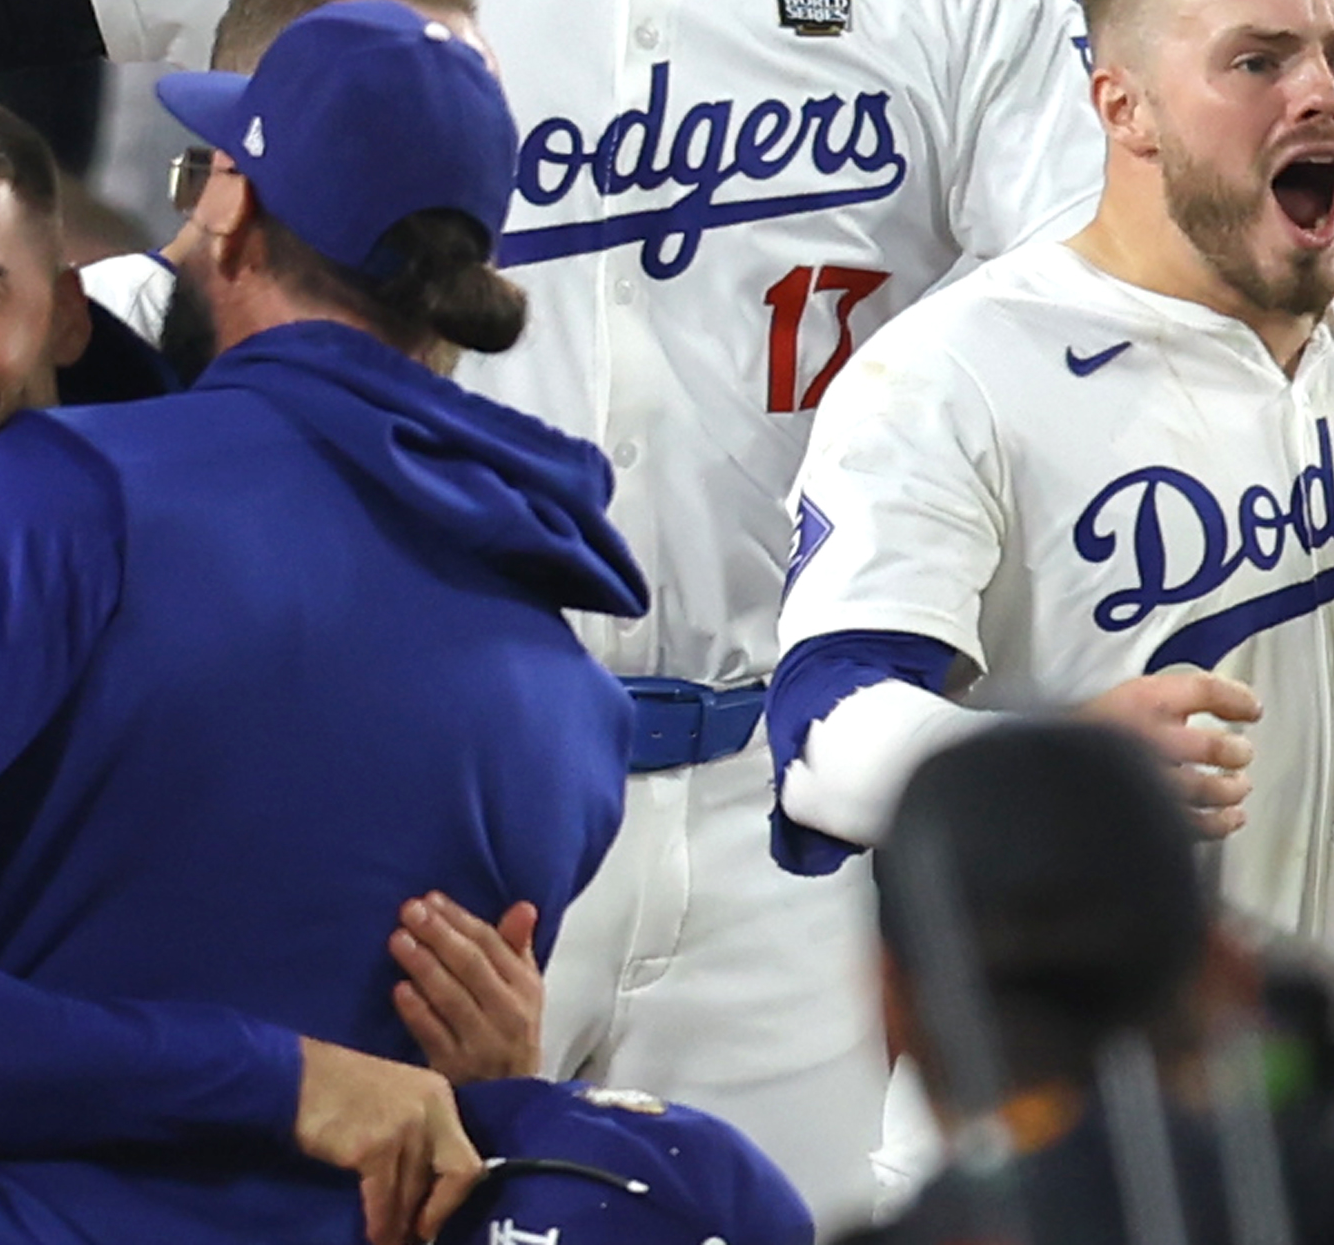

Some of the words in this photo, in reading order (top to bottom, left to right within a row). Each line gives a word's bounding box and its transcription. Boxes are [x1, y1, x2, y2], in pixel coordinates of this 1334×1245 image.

[784, 6, 850, 23] SERIES
[515, 59, 907, 280] odgers
[763, 265, 893, 413] 17
